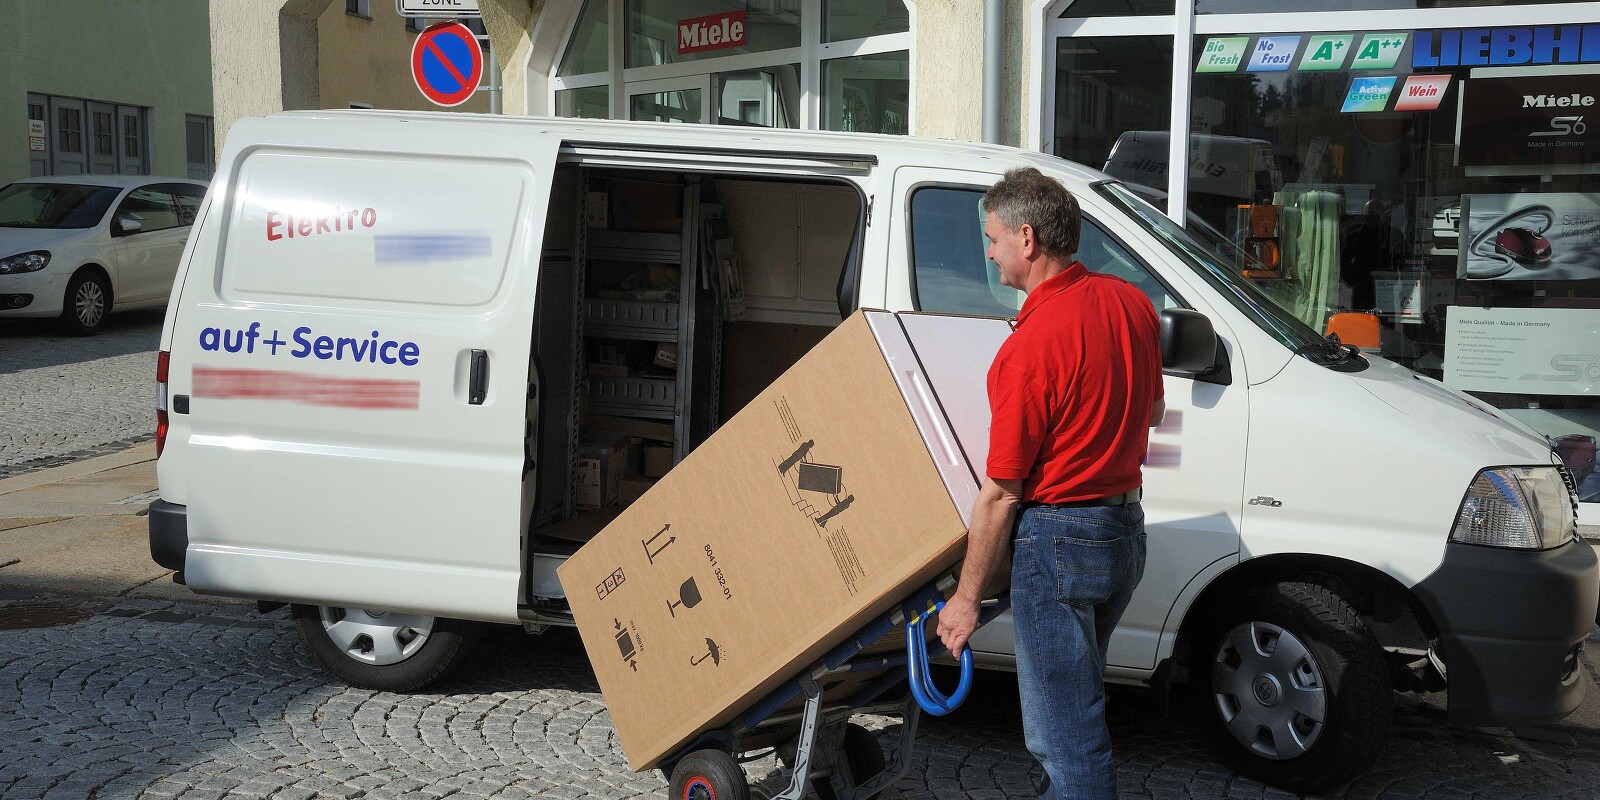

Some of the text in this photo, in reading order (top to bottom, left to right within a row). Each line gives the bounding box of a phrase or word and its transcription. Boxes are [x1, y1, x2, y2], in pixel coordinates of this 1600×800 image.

[680, 18, 744, 49] Miele
[1206, 41, 1225, 52] Bio
[1258, 40, 1274, 51] No
[1311, 41, 1344, 61] A+
[1357, 39, 1402, 60] A++
[1209, 53, 1239, 64] Fresh
[1261, 53, 1291, 64] Frost
[1350, 91, 1387, 101] Green
[1359, 85, 1390, 94] Active
[1408, 85, 1438, 97] Wein
[1522, 93, 1596, 108] Miele
[1528, 115, 1587, 137] S6
[267, 206, 376, 241] Elektro
[704, 543, 733, 600] 8041 332-01
